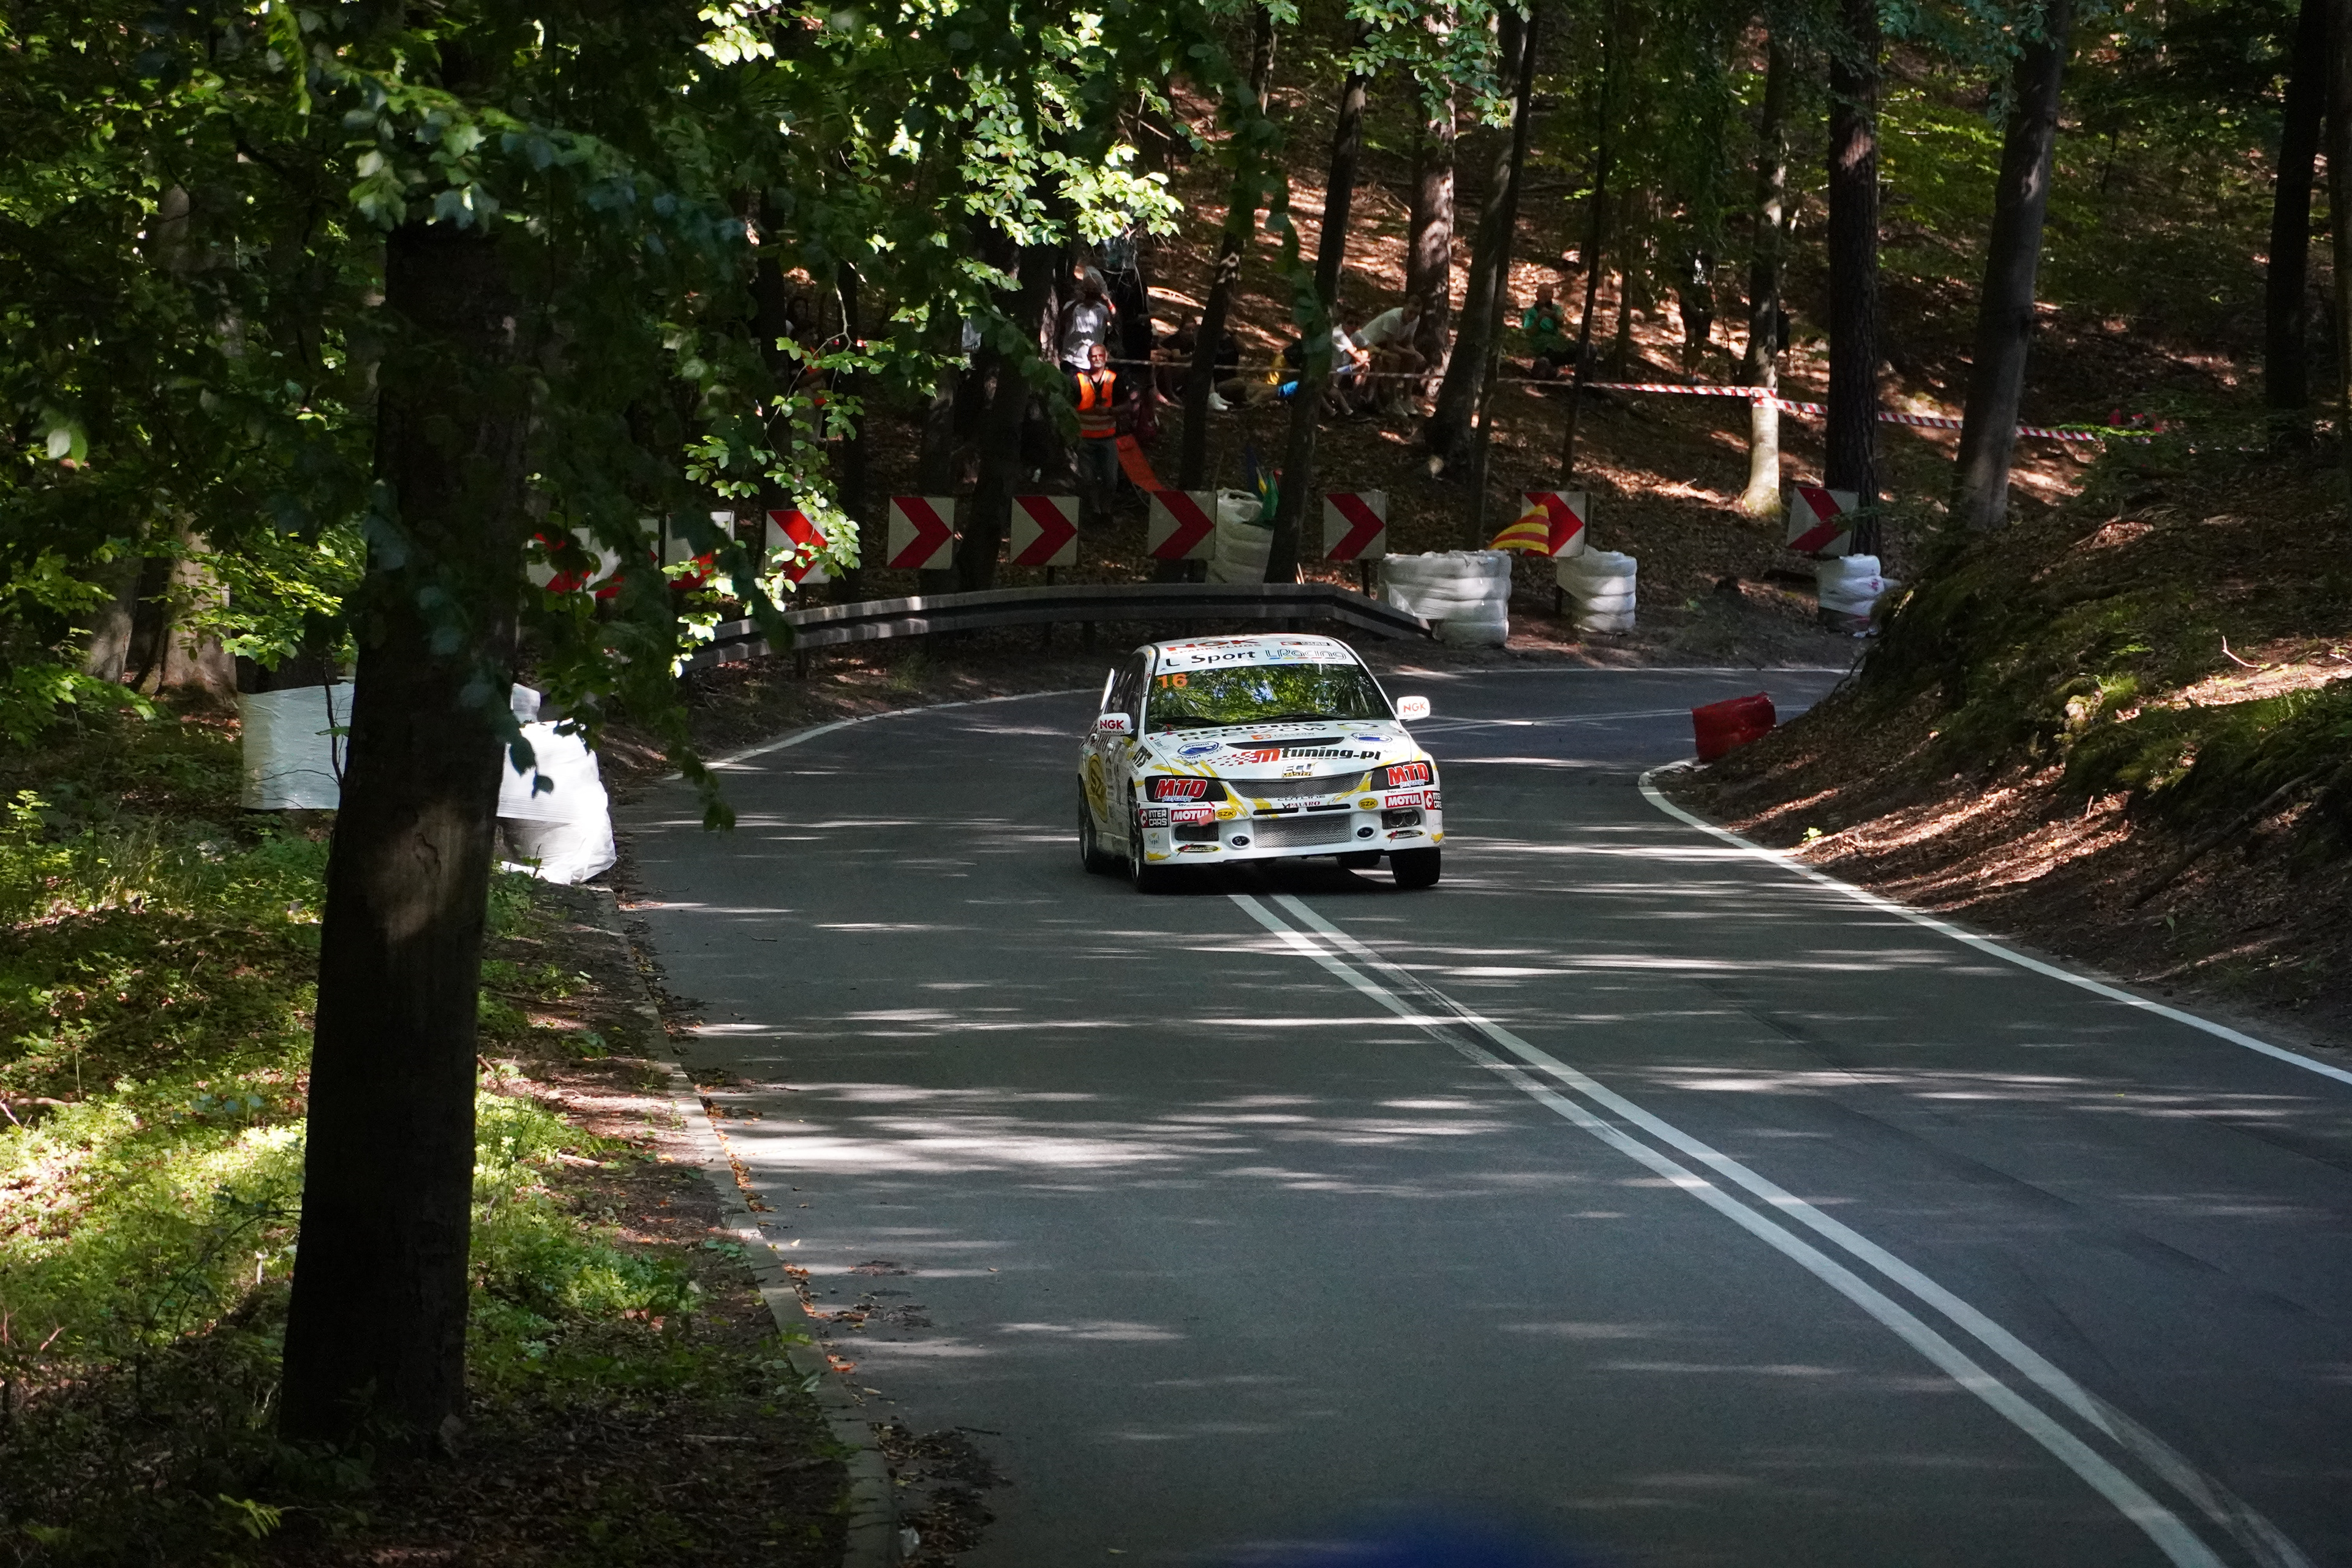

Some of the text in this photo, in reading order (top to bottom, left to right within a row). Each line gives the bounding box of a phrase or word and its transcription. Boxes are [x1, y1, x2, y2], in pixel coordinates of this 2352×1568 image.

[1166, 639, 1259, 652] NGK
[1191, 650, 1256, 664] Sport
[1157, 673, 1188, 688] 16
[1403, 701, 1427, 713] NGK
[1099, 719, 1125, 730] NGK
[1283, 763, 1315, 773] ECU
[1386, 763, 1430, 786] MTD
[1154, 778, 1207, 800] MTD
[1387, 794, 1421, 807] MOTUL
[1148, 810, 1167, 818] INTER
